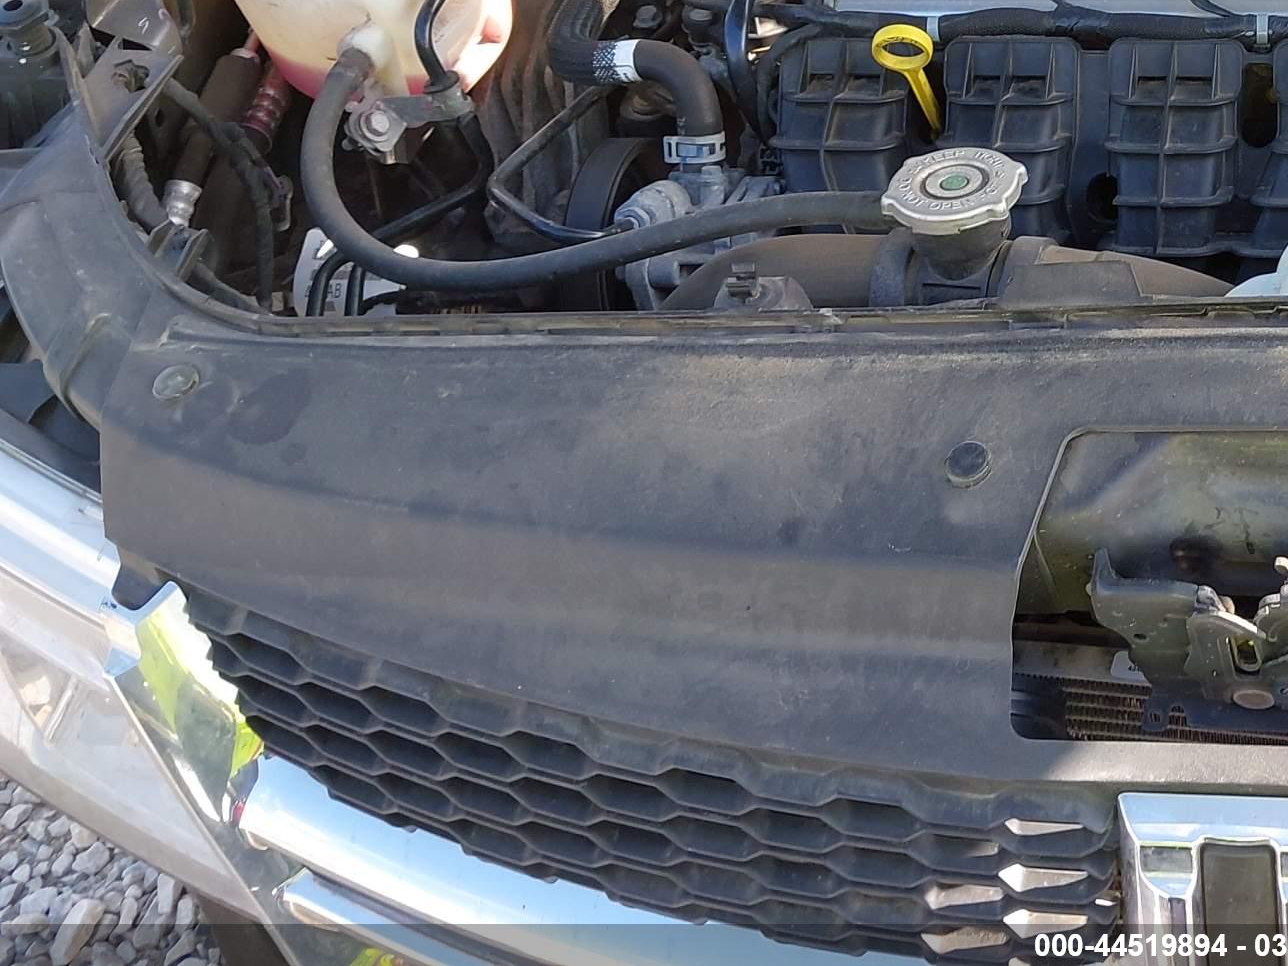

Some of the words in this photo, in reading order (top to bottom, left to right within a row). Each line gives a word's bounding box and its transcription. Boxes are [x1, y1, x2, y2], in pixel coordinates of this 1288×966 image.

[921, 149, 966, 165] KEEP
[901, 190, 927, 208] NOT
[929, 198, 976, 211] OPEN
